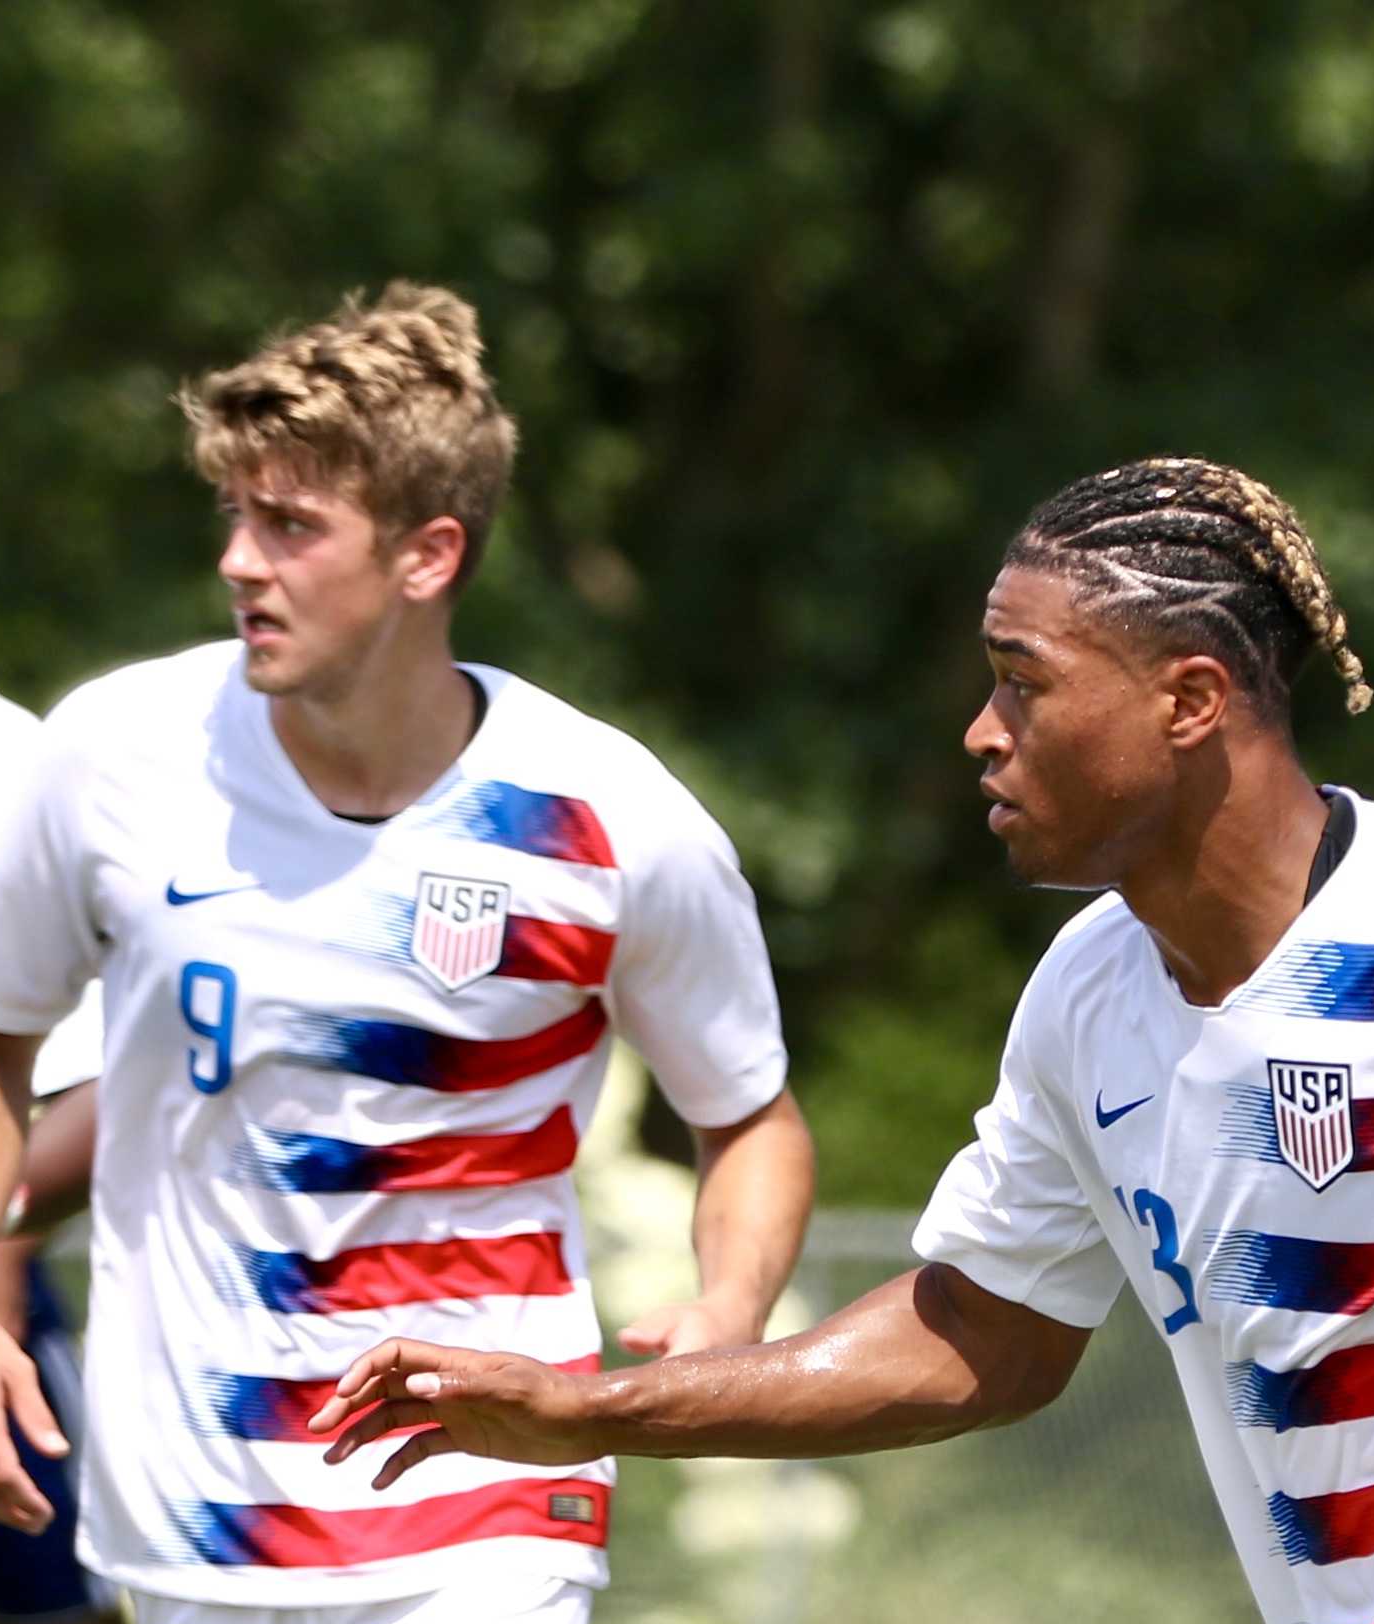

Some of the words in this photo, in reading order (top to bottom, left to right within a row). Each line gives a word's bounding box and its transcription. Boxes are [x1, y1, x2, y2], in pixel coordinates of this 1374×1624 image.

[429, 882, 501, 924] USA
[181, 961, 236, 1094] 9
[1278, 1068, 1342, 1114] USA
